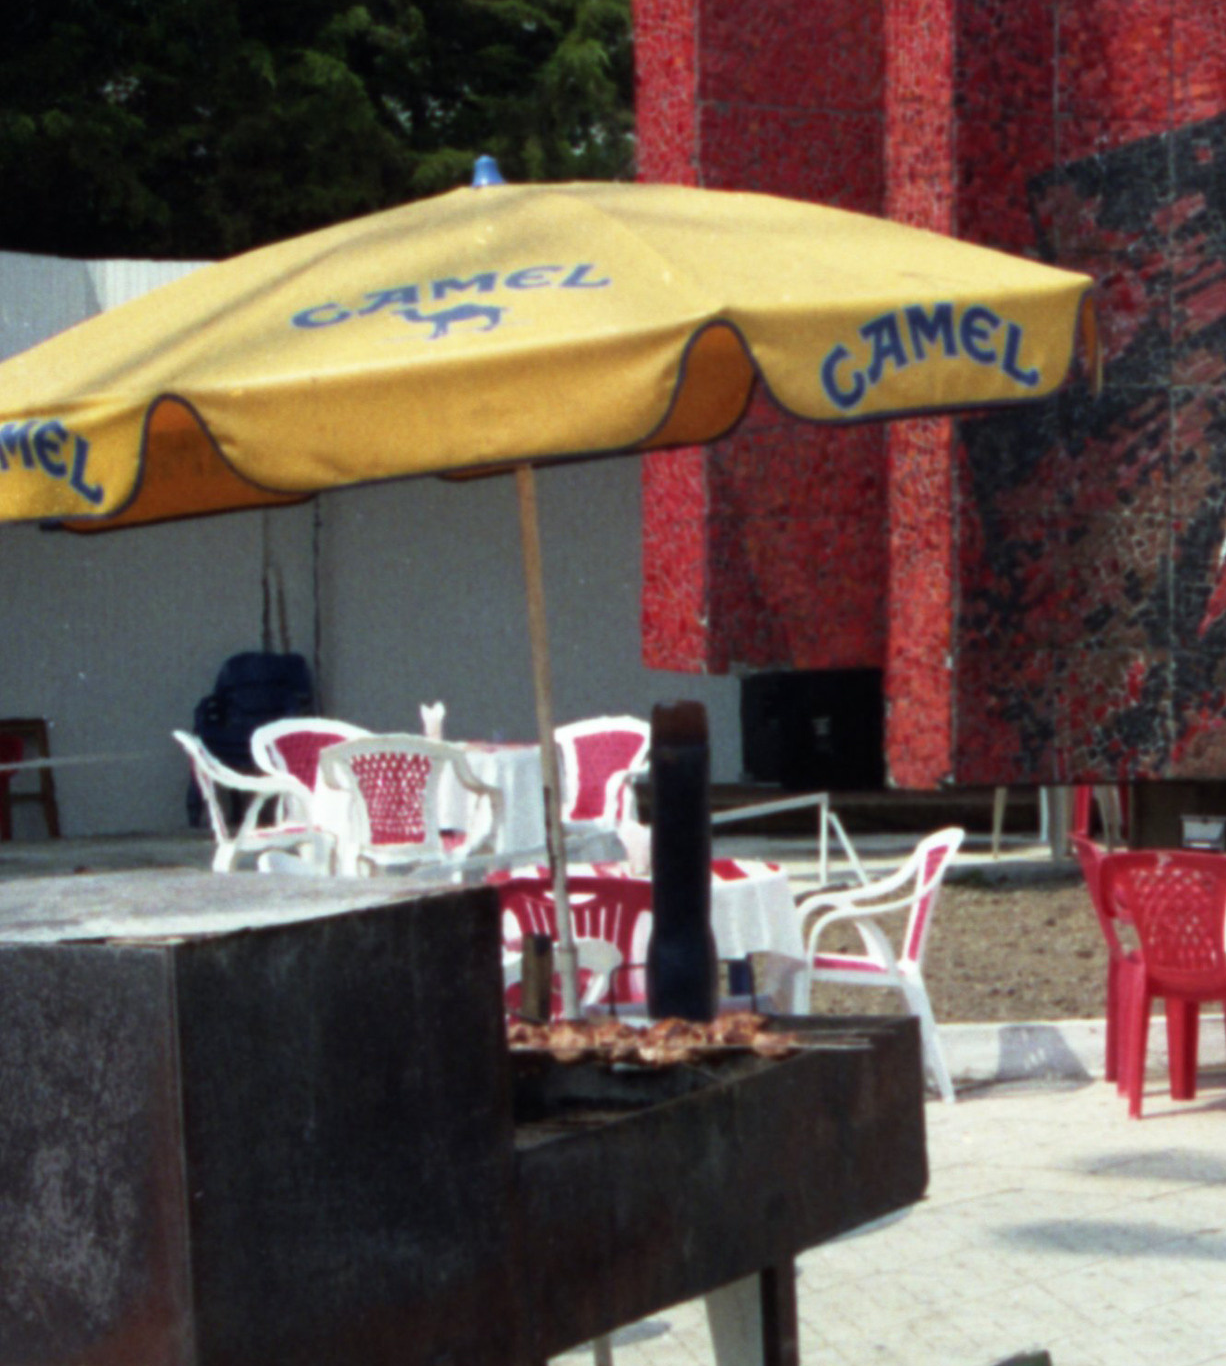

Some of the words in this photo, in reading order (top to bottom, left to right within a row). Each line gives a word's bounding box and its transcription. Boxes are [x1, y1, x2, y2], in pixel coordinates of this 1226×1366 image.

[291, 264, 611, 329] CAMEL
[820, 302, 1040, 409] CAMEL
[0, 419, 104, 505] MEL
